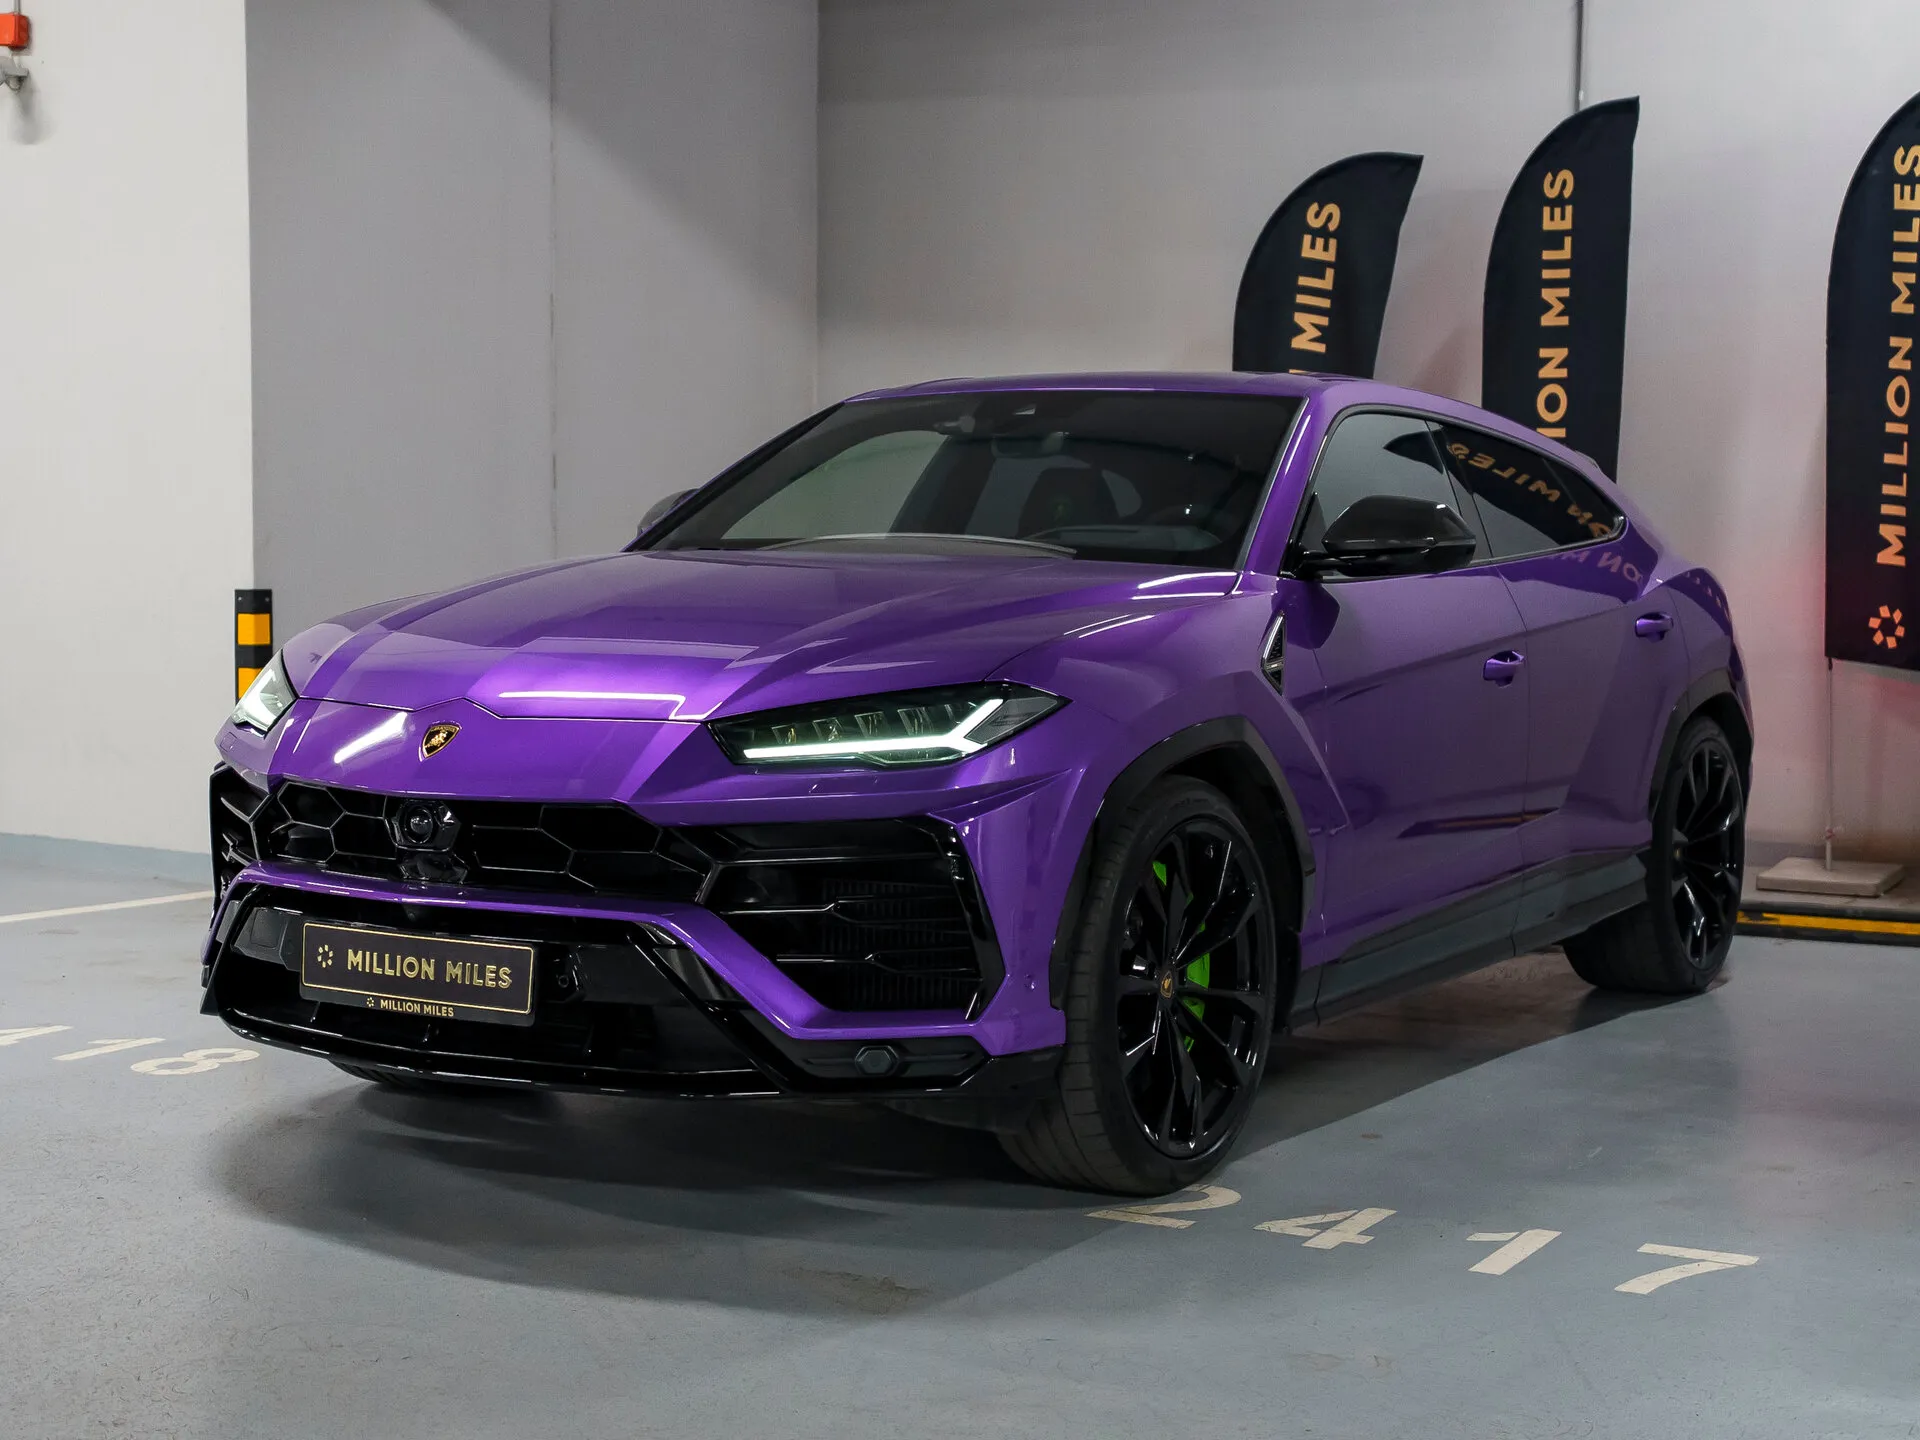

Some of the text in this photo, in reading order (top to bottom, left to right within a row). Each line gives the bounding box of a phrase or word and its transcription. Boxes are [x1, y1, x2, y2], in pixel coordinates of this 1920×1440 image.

[1290, 201, 1341, 354] MILES
[1540, 168, 1574, 327] MILES
[1876, 144, 1920, 567] MILLION MILES
[347, 948, 513, 989] MILLION MILES
[380, 999, 455, 1017] MILLION MILES
